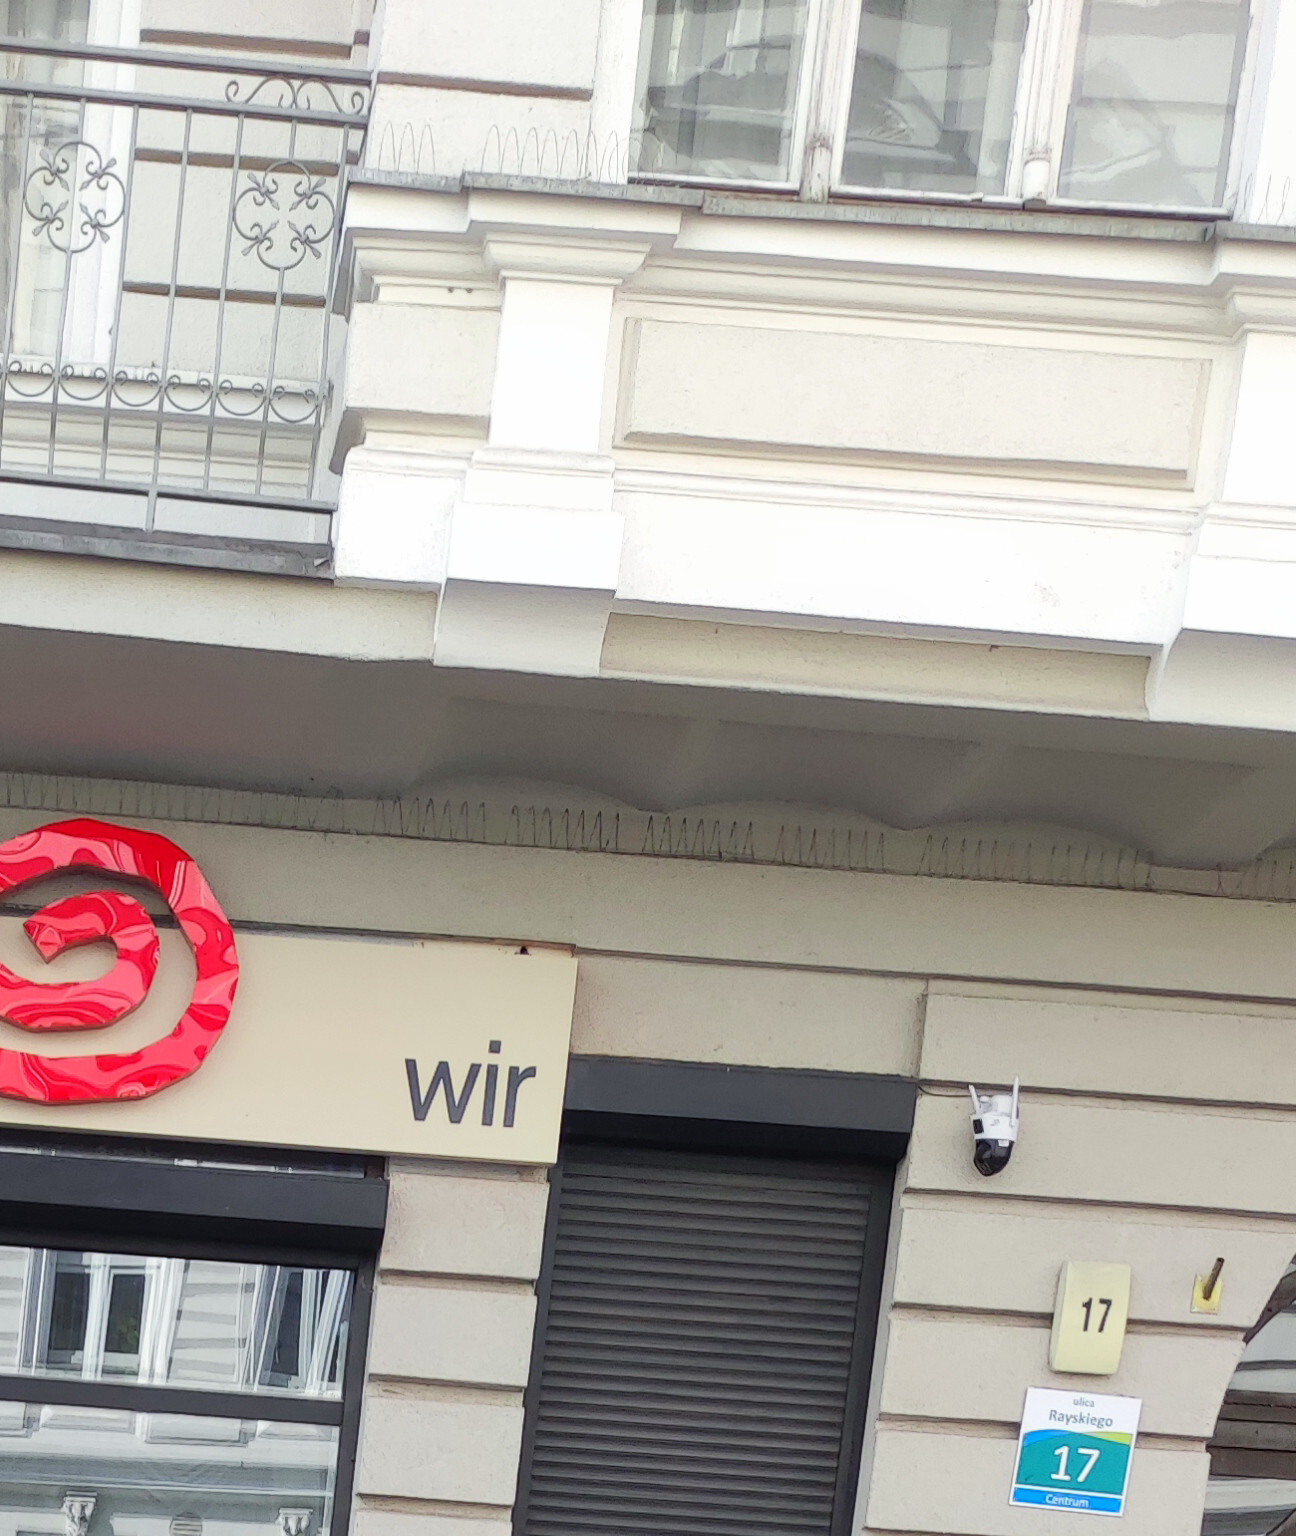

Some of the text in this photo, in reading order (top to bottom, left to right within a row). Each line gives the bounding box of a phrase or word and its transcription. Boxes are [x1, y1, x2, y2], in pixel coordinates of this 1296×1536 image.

[405, 1040, 536, 1127] wir
[1082, 1297, 1112, 1333] 17
[1073, 1397, 1095, 1408] ulica
[1048, 1409, 1114, 1429] Rayskiego
[1050, 1445, 1101, 1483] 17
[1045, 1494, 1089, 1508] Centrum
